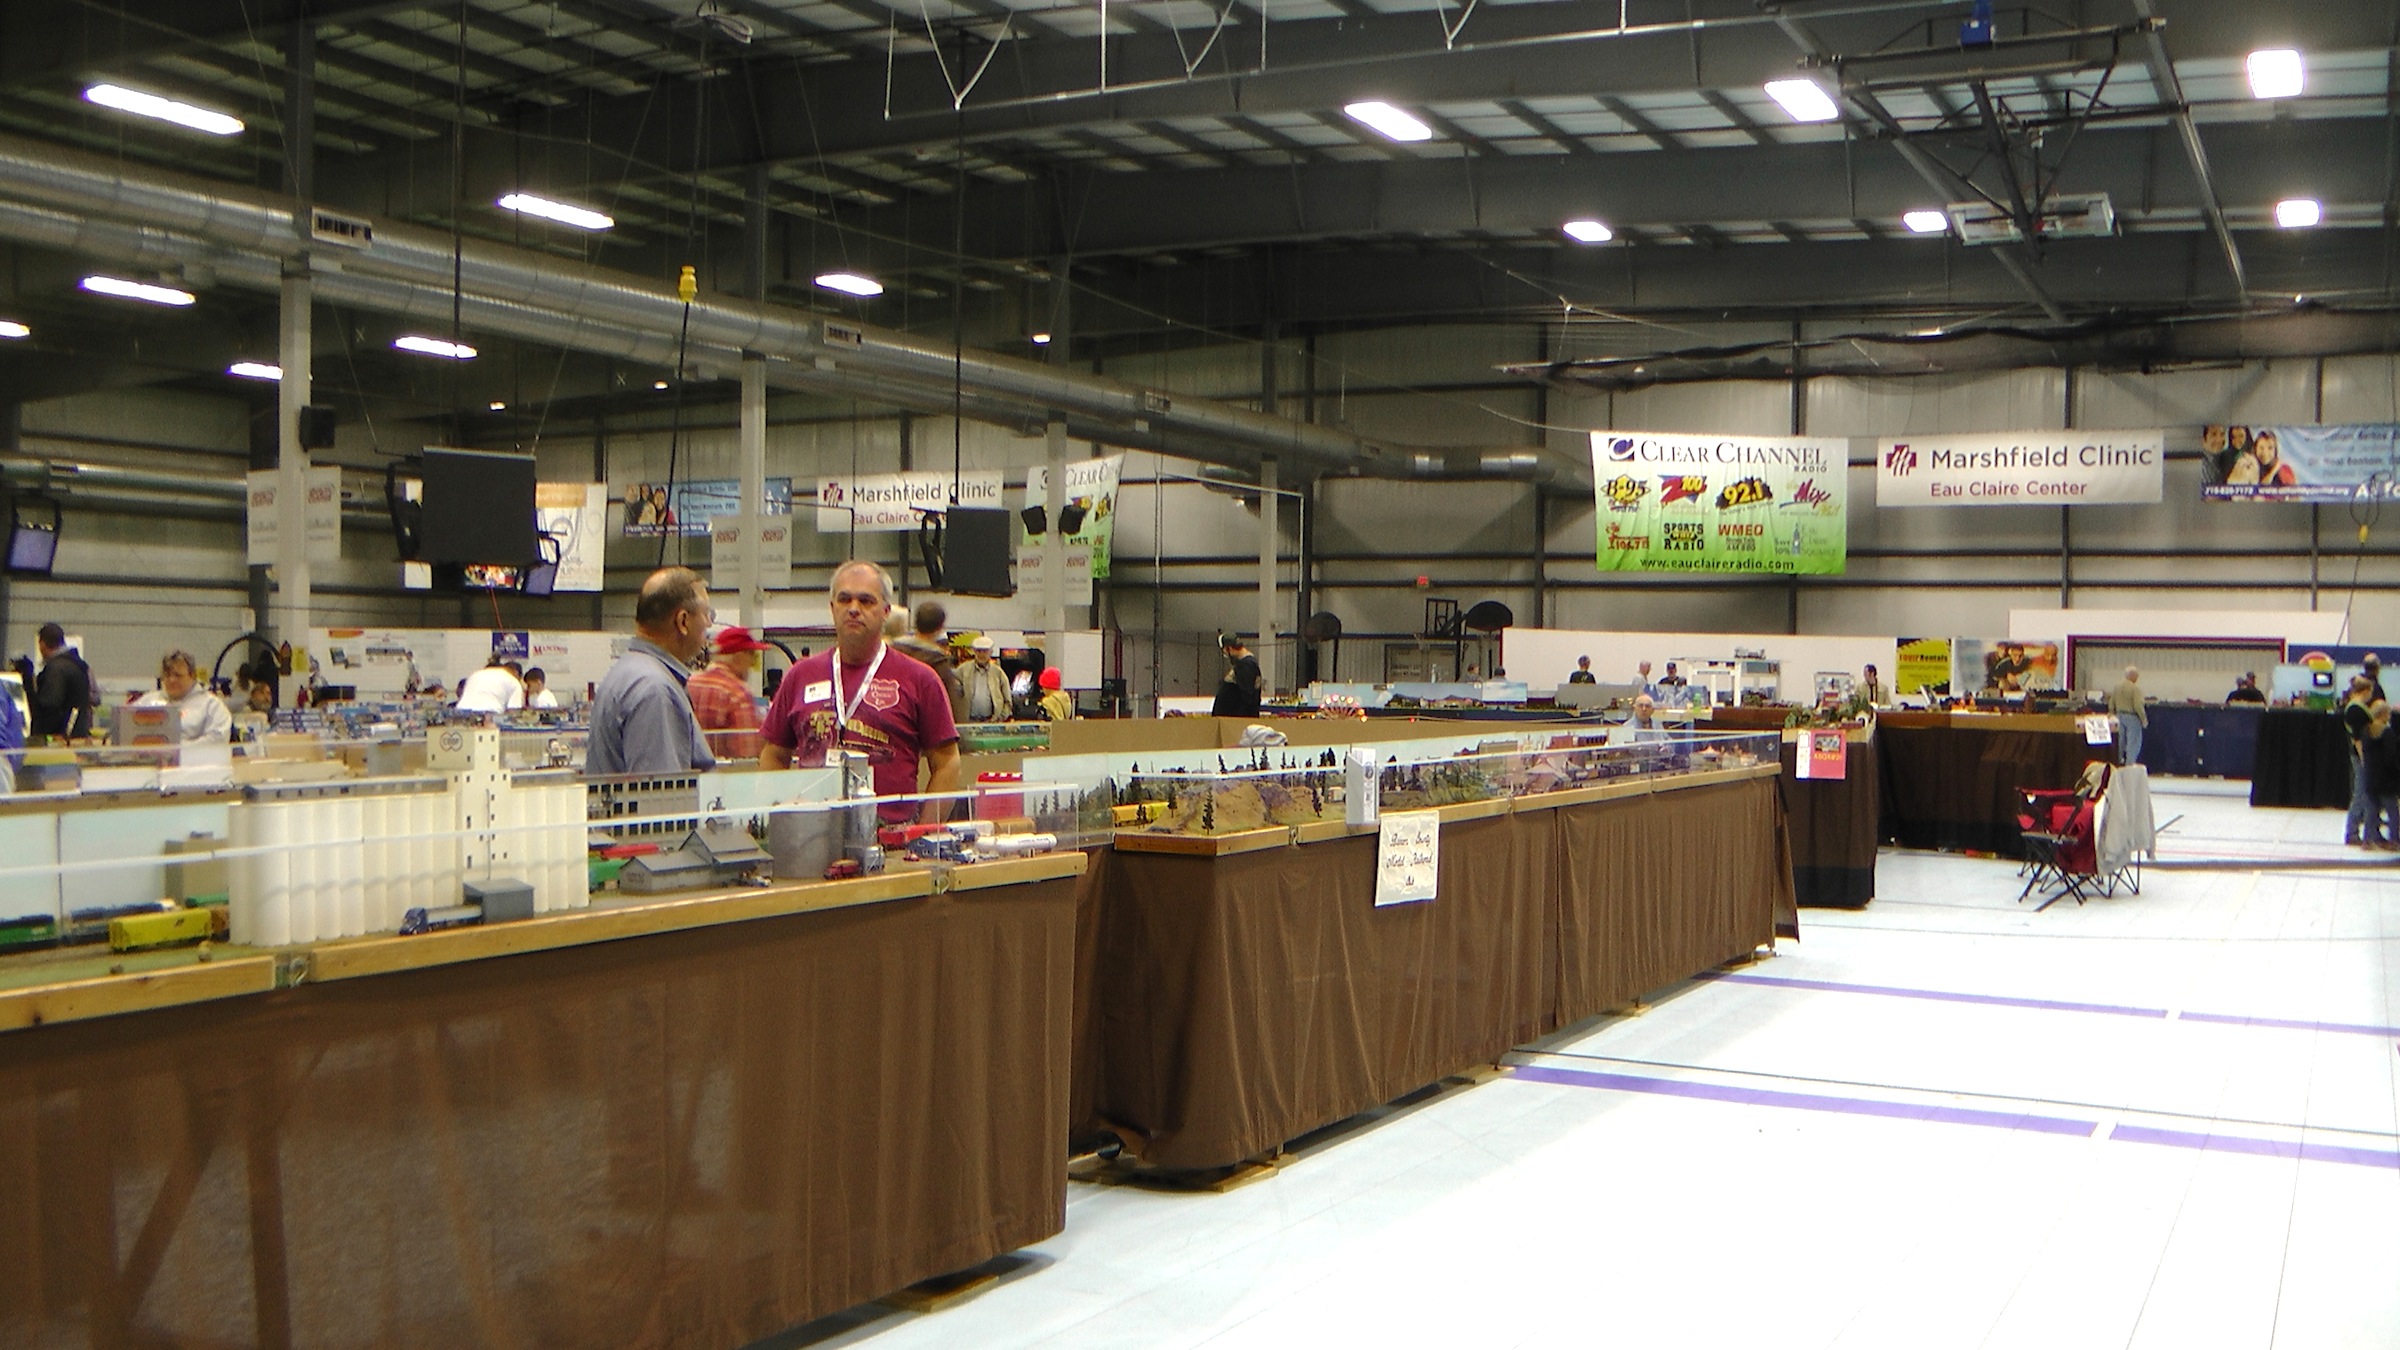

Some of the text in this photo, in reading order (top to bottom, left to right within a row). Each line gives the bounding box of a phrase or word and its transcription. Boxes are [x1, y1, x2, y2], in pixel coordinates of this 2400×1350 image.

[1641, 440, 1829, 466] CLEAR CHANNEL
[1931, 444, 2153, 470] Marshfield Clinic
[1794, 465, 1828, 473] RADIO
[853, 482, 942, 503] Marshfield
[1724, 480, 1765, 505] 92.1
[1793, 478, 1832, 509] Mix
[1931, 480, 2088, 497] Eau Claire Center
[877, 512, 910, 524] Claire
[1664, 523, 1705, 535] SPORTS
[1718, 523, 1764, 537] WMEQ
[1664, 539, 1705, 551] RADIO
[1640, 557, 1795, 571] www.eauclaireradio.com
